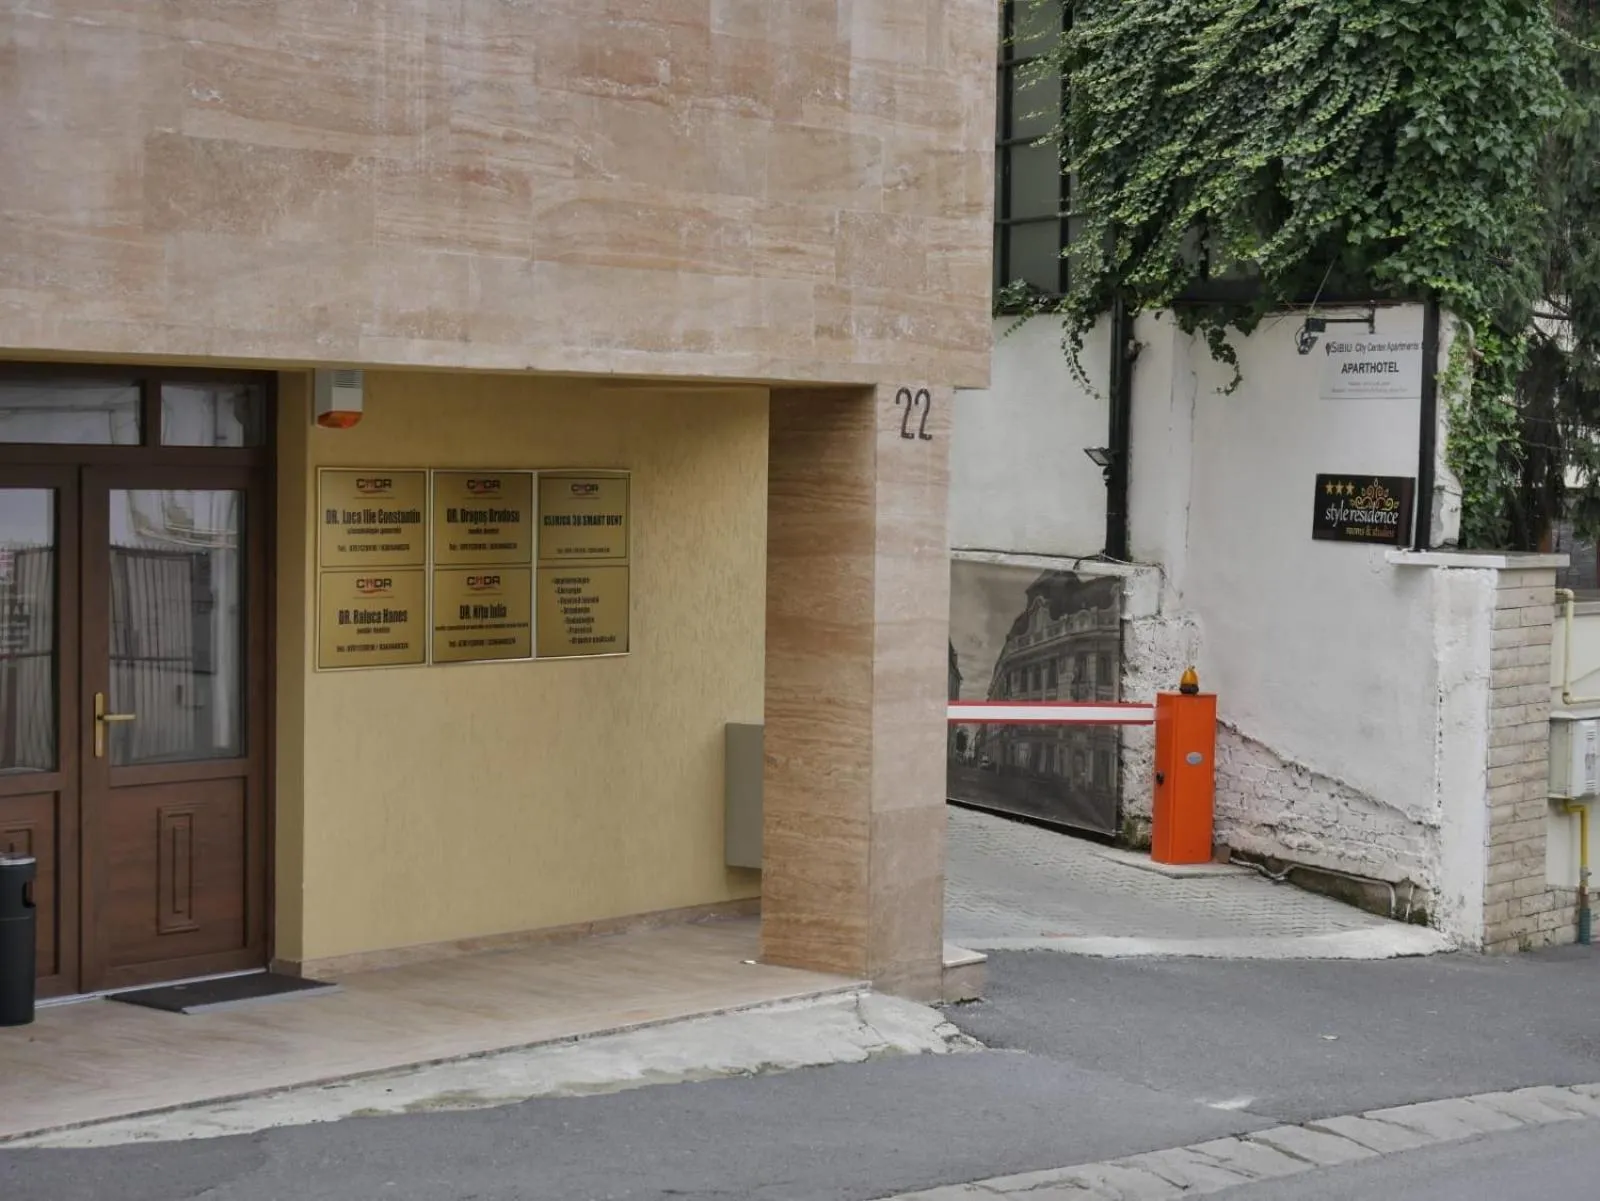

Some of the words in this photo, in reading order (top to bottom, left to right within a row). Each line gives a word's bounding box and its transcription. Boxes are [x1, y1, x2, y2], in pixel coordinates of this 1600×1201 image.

[1355, 342, 1366, 354] City
[1341, 361, 1400, 374] APARTHOTEL
[895, 387, 933, 440] 22
[1350, 502, 1400, 524] residence
